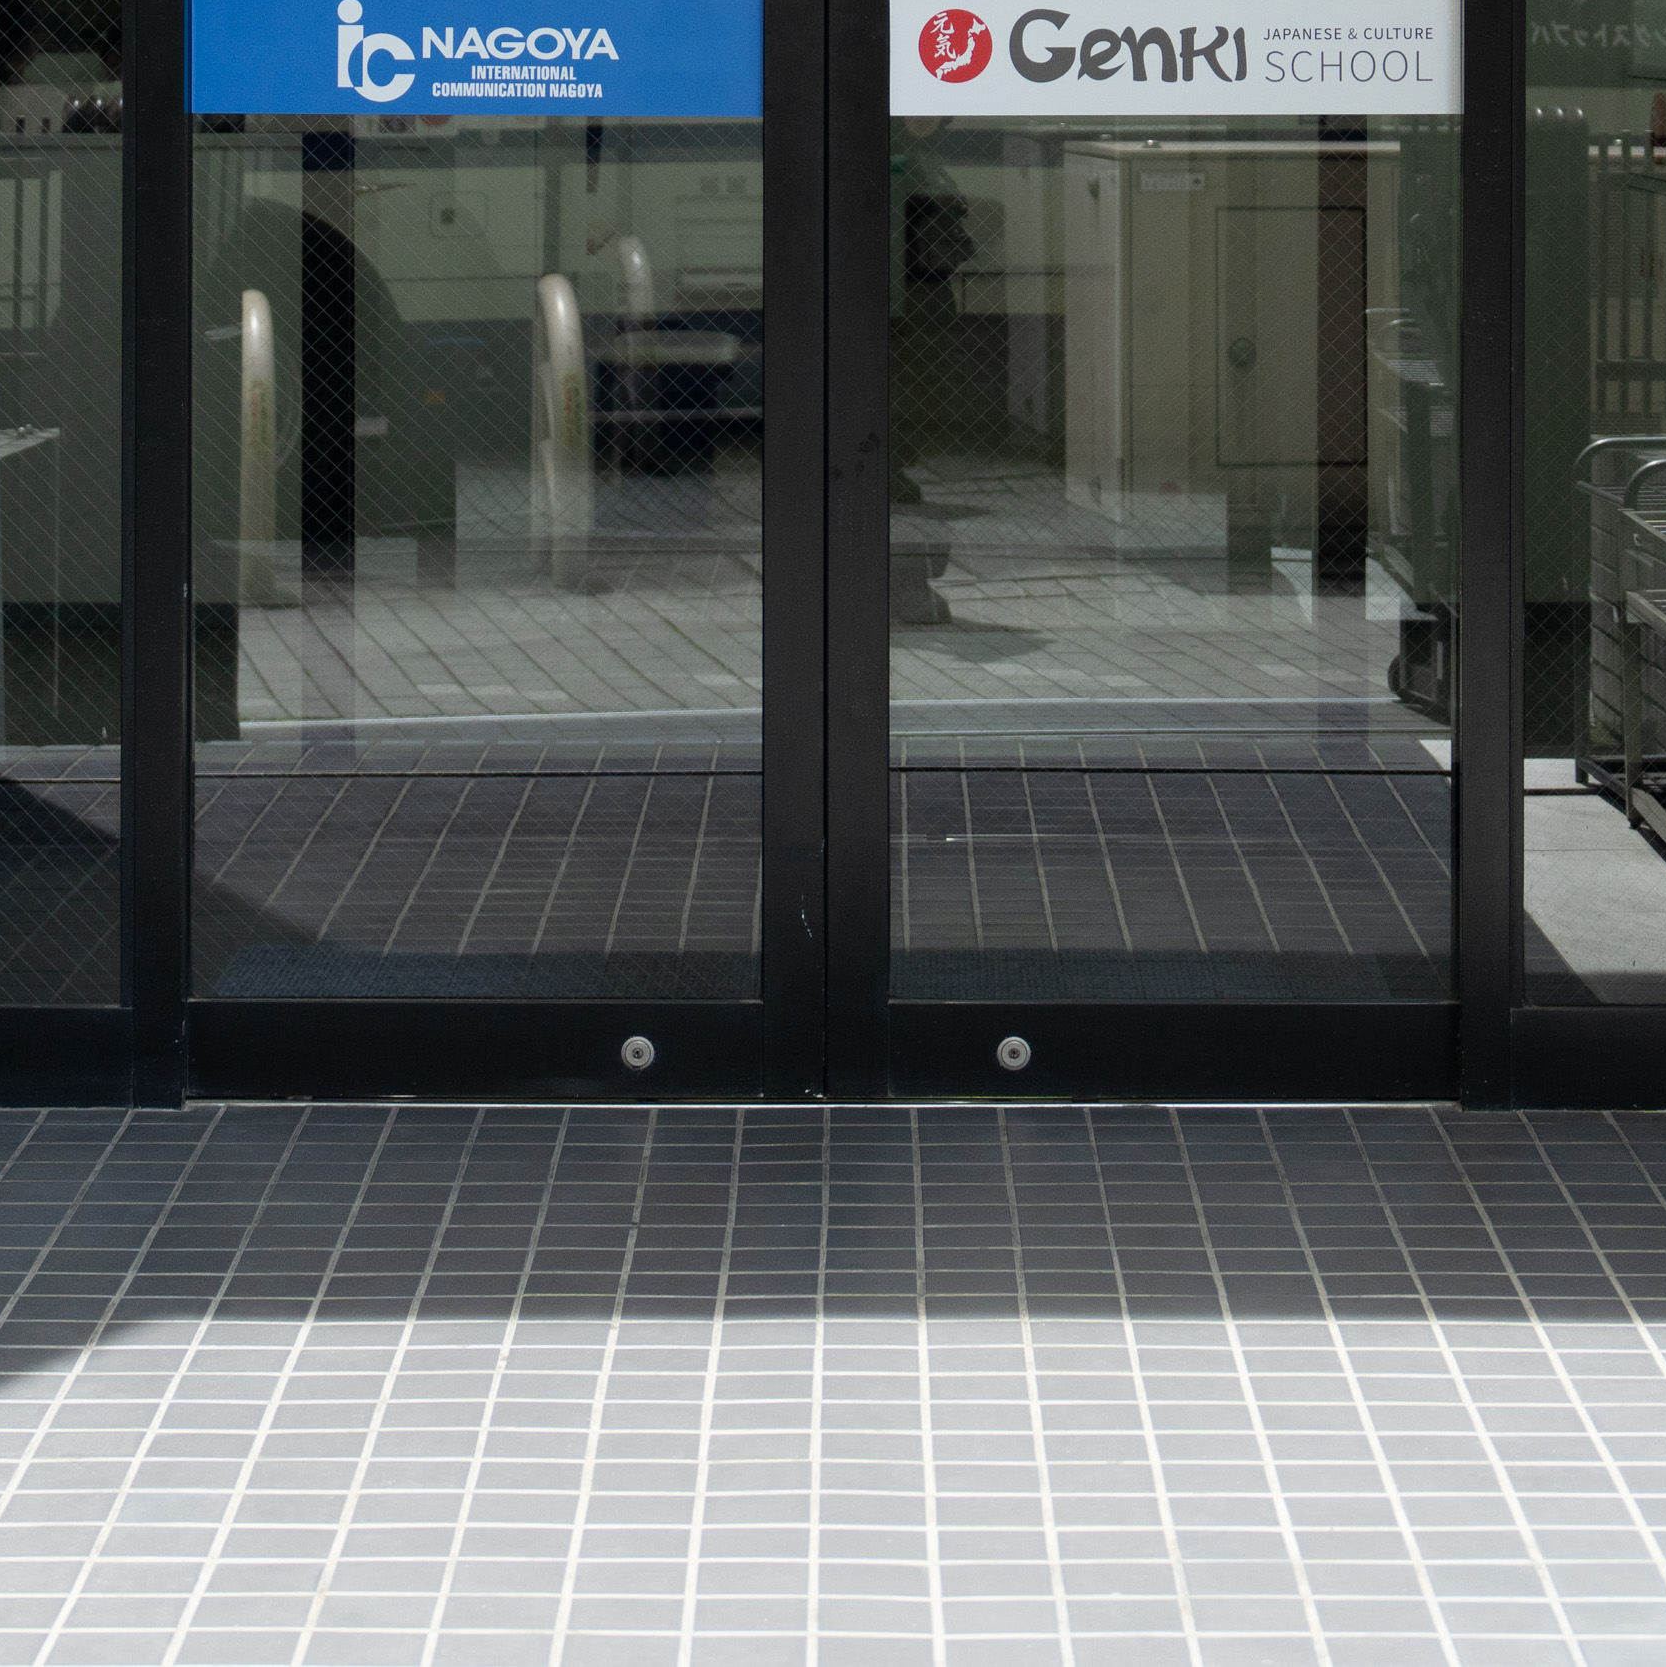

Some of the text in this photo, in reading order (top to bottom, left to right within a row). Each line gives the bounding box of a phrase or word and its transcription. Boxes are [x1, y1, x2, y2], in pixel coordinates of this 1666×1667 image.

[422, 27, 620, 60] NAGOYA
[930, 12, 957, 60] 元気
[1263, 27, 1434, 41] JAPANESE & CULTURE
[471, 65, 577, 81] INTERNATIONAL
[1264, 50, 1434, 83] SCHOOL
[432, 82, 603, 98] COMMUNICATION NAGOYA
